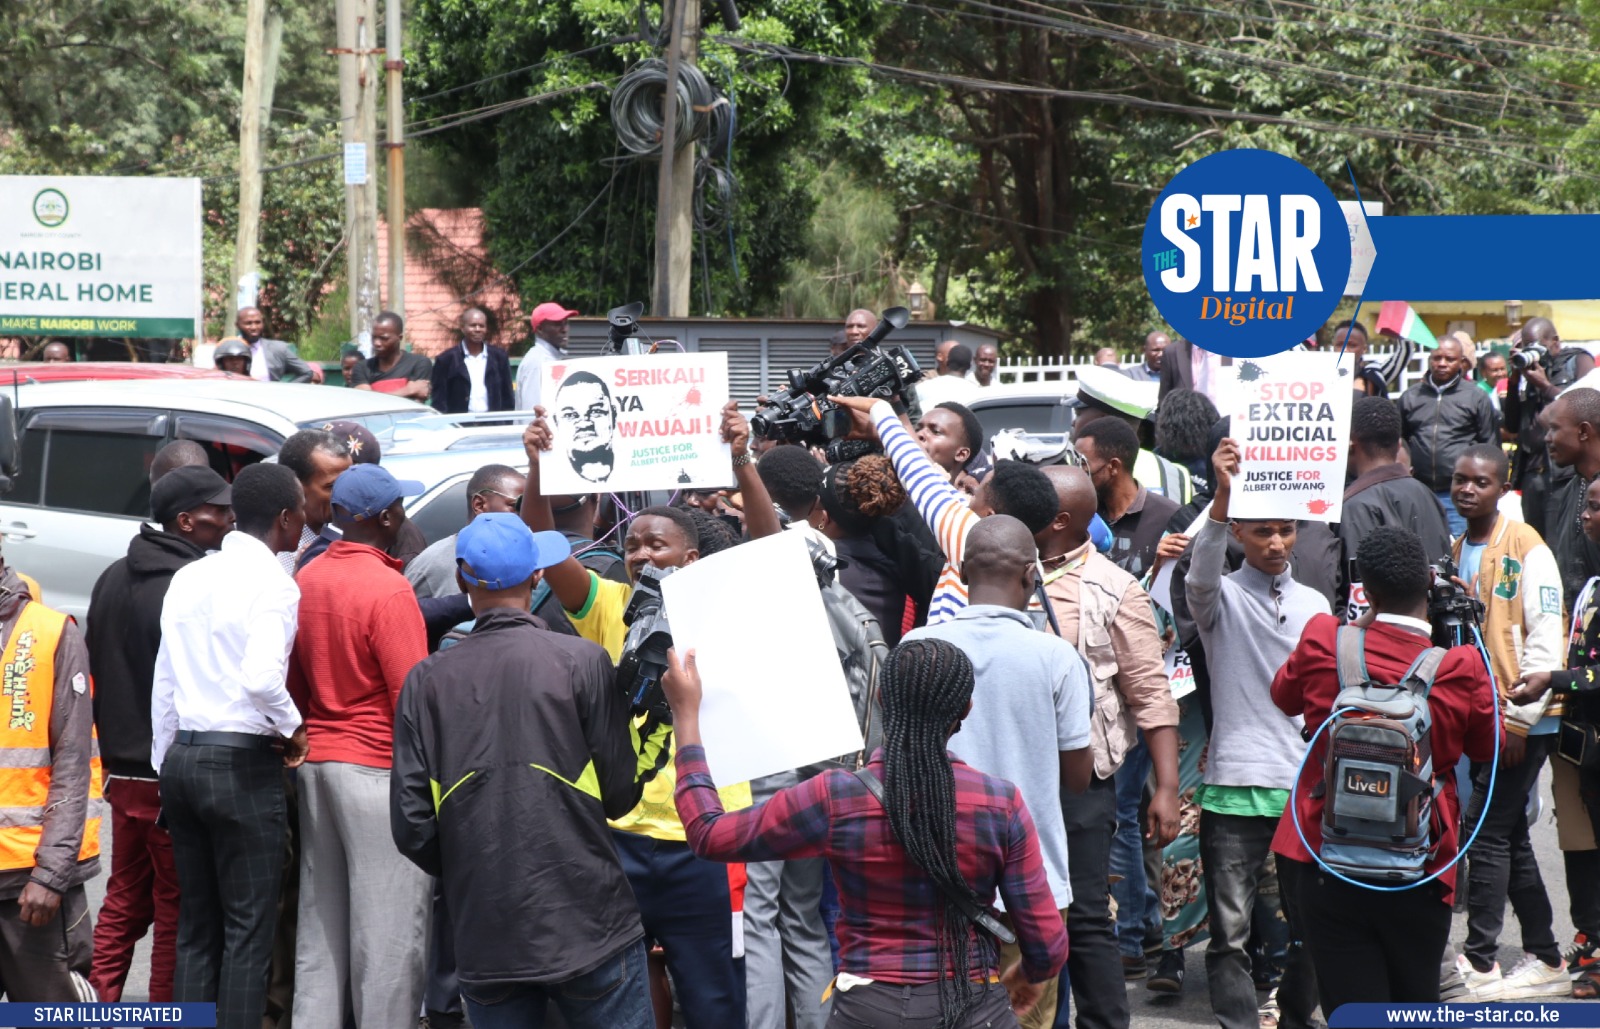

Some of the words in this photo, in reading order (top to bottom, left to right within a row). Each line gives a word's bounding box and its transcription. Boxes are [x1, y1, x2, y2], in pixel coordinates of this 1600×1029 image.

[0, 251, 101, 271] NAIROBI
[0, 282, 69, 301] ERAL
[77, 283, 153, 302] HOME
[2, 318, 38, 329] MAKE
[40, 319, 95, 330] NAIROBI
[97, 320, 137, 331] WORK
[614, 367, 705, 387] SERIKALI
[1260, 382, 1325, 401] STOP
[615, 395, 644, 412] YA
[1249, 403, 1334, 421] EXTRA
[1246, 426, 1336, 441] JUDICIAL
[631, 444, 671, 459] JUSTICE
[673, 442, 693, 453] FOR
[1244, 446, 1336, 461] KILLINGS
[630, 456, 659, 467] ALBERT
[661, 452, 698, 464] OJWANG
[1245, 471, 1292, 482] JUSTICE
[1296, 470, 1321, 480] FOR
[1243, 483, 1277, 492] ALBERT
[1279, 482, 1325, 491] OJWANG
[3, 663, 14, 695] GAME
[1348, 774, 1389, 795] LiveU
